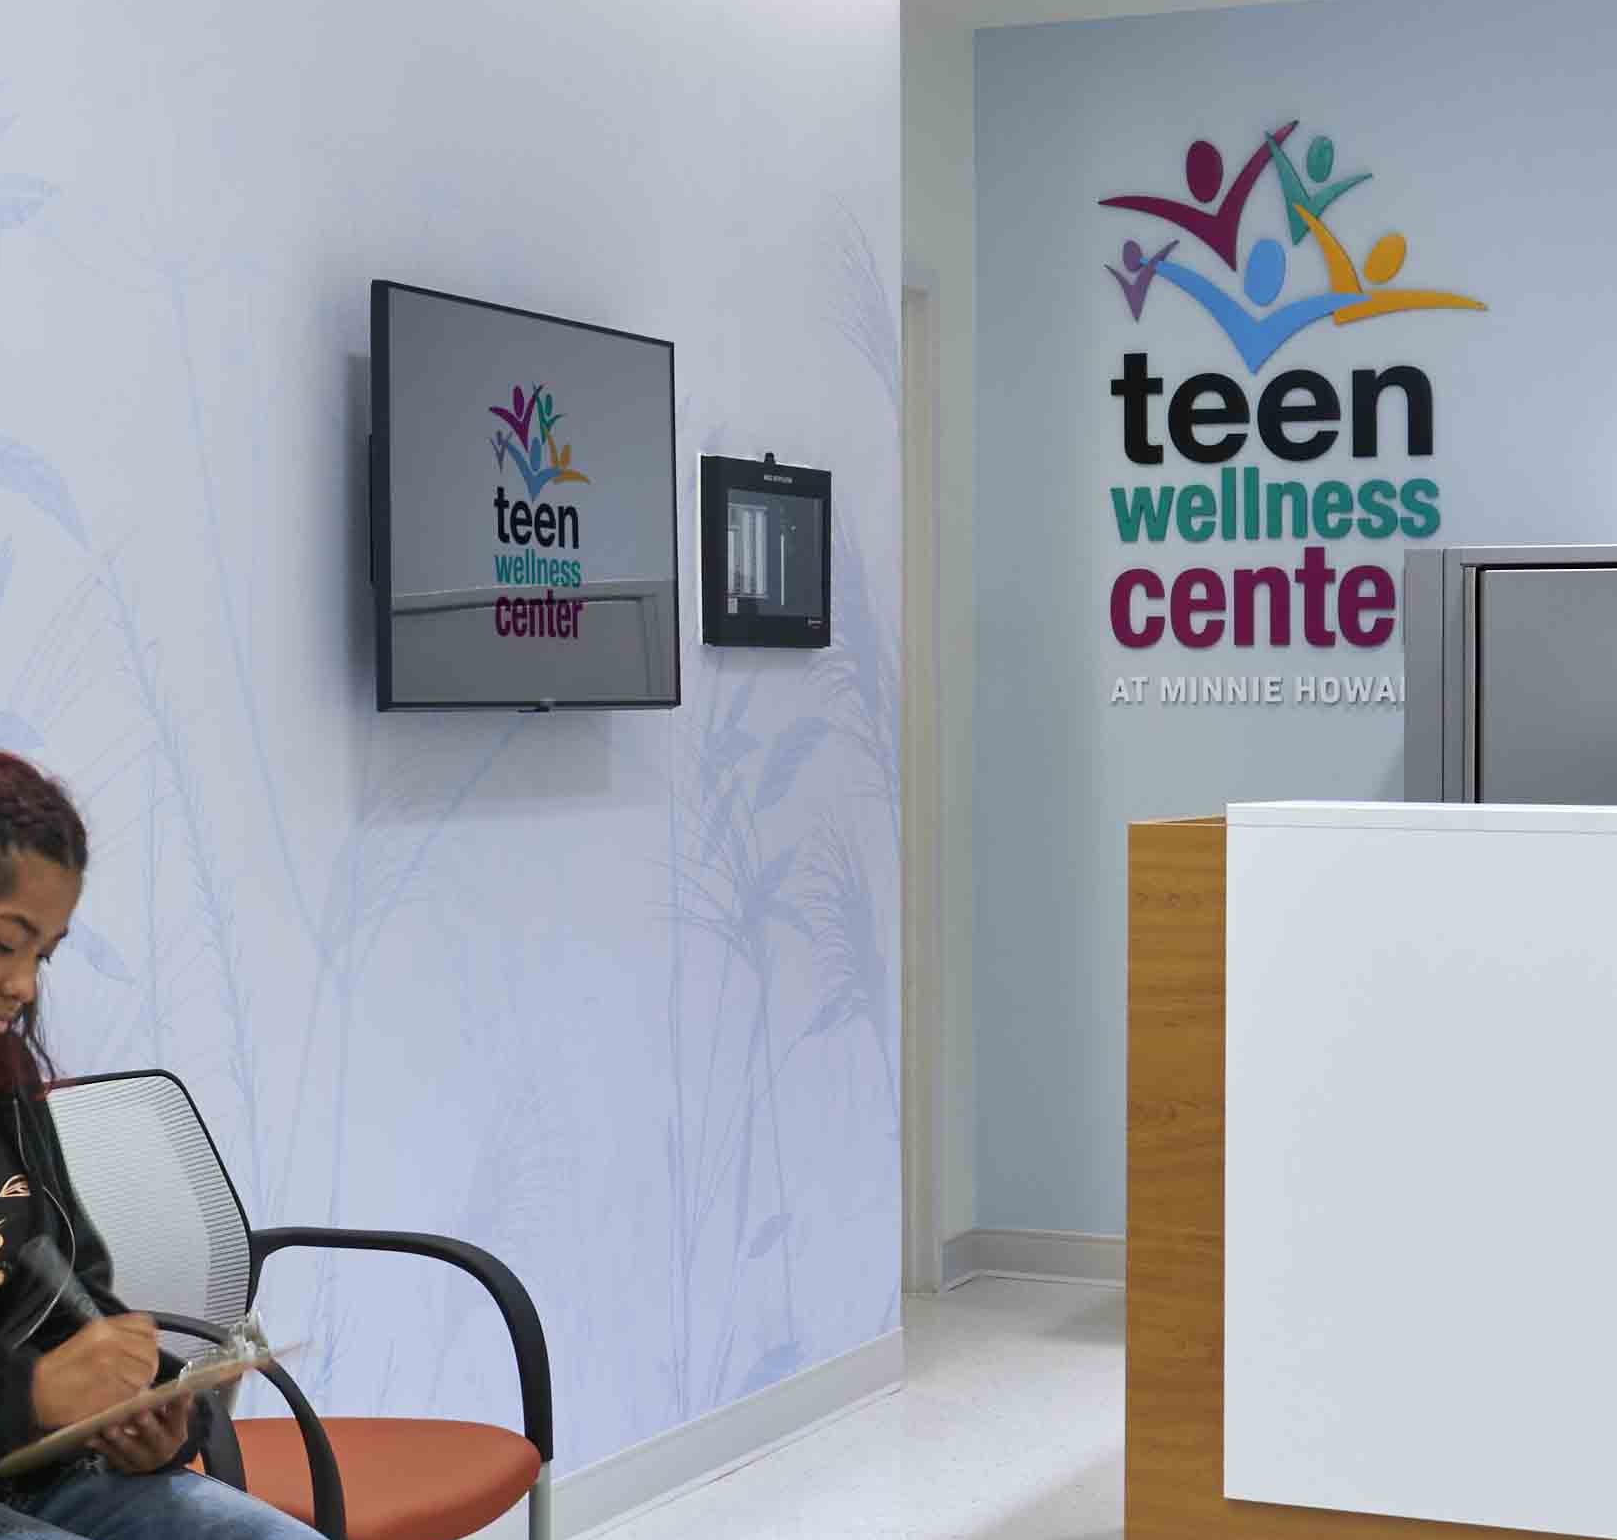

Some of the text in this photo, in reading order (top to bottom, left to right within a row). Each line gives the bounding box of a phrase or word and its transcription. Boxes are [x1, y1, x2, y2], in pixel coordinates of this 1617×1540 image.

[1110, 352, 1434, 465] teen
[494, 486, 580, 550] teen
[1110, 466, 1441, 542] wellness
[495, 549, 582, 589] wellness
[1109, 546, 1405, 649] cente
[495, 589, 585, 639] center
[1110, 676, 1405, 704] AT MINNIE HOWA
